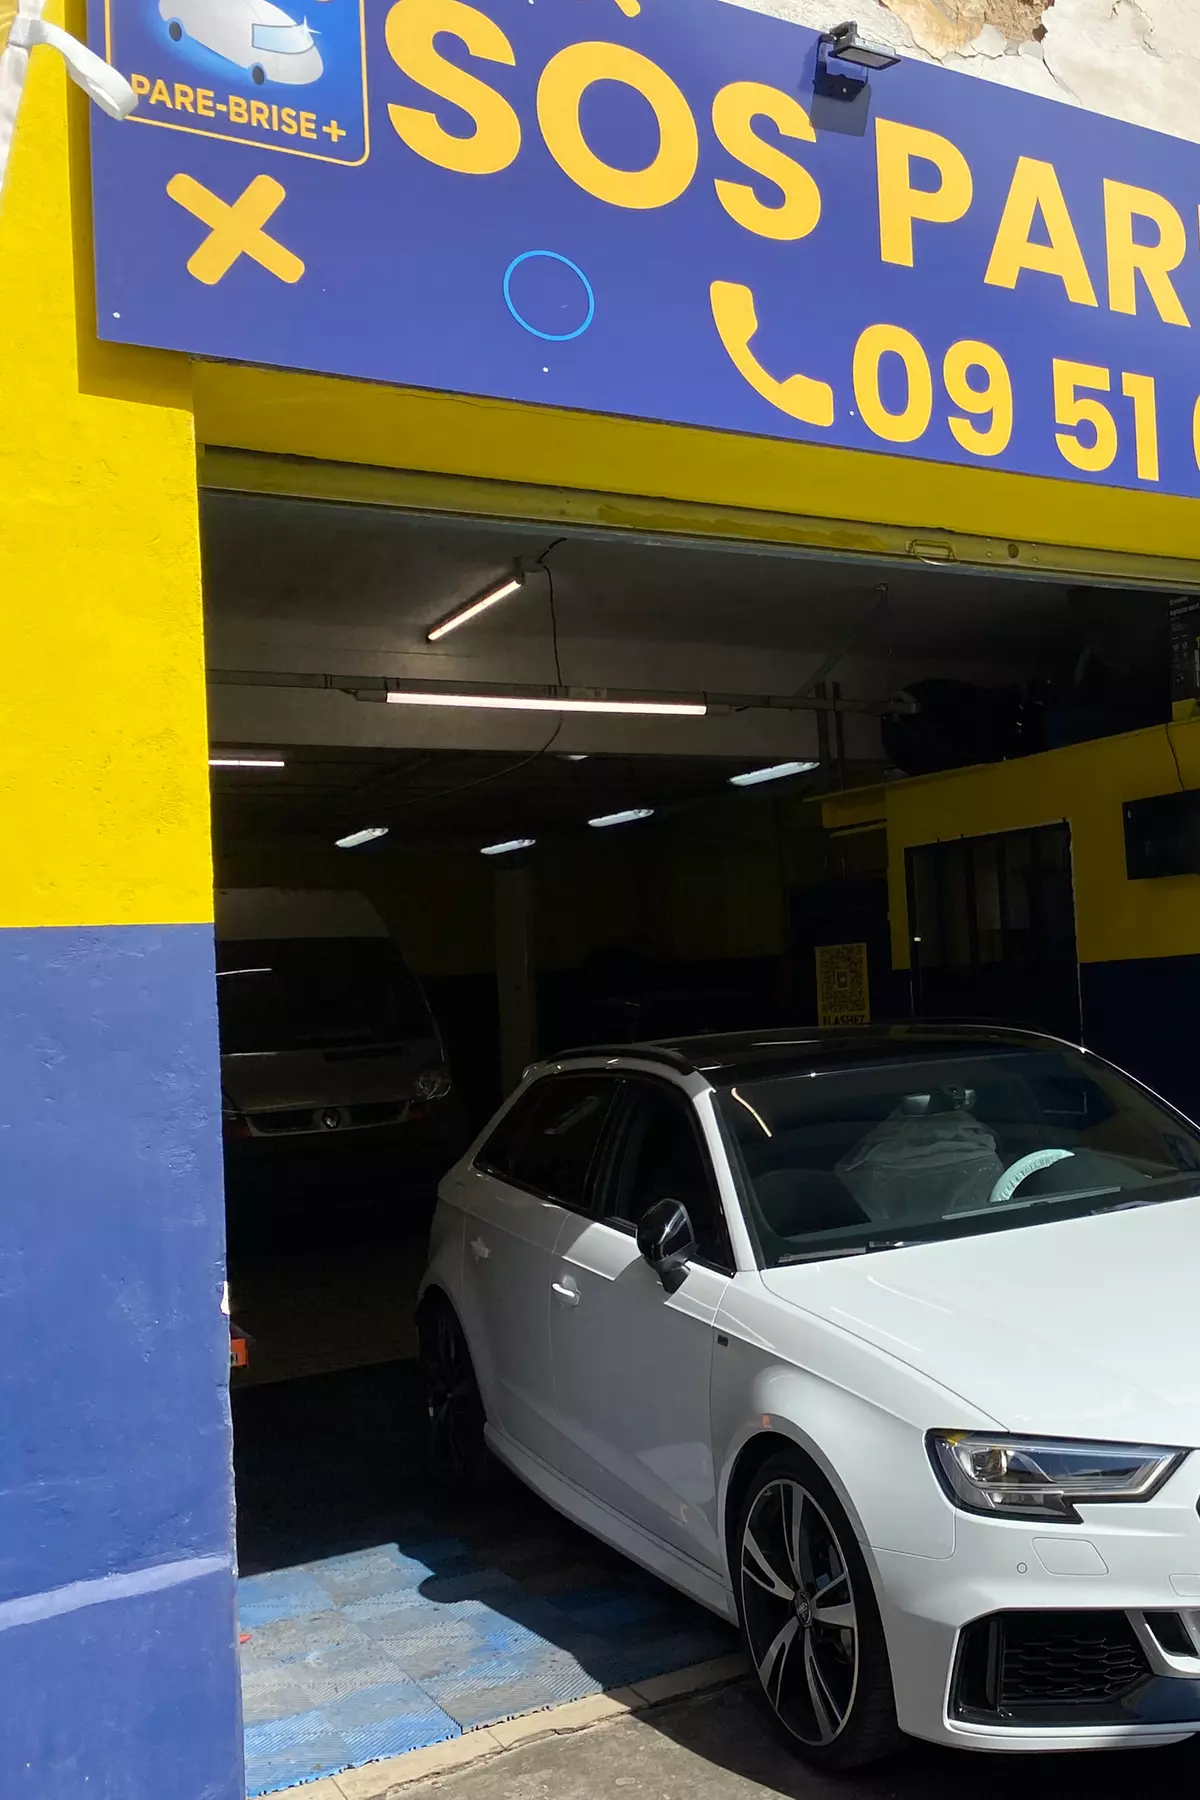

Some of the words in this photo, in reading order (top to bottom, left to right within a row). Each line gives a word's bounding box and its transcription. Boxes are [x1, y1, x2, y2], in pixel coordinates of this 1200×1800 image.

[385, 0, 821, 240] SOS
[852, 324, 1013, 457] 09
[1052, 357, 1160, 481] 51
